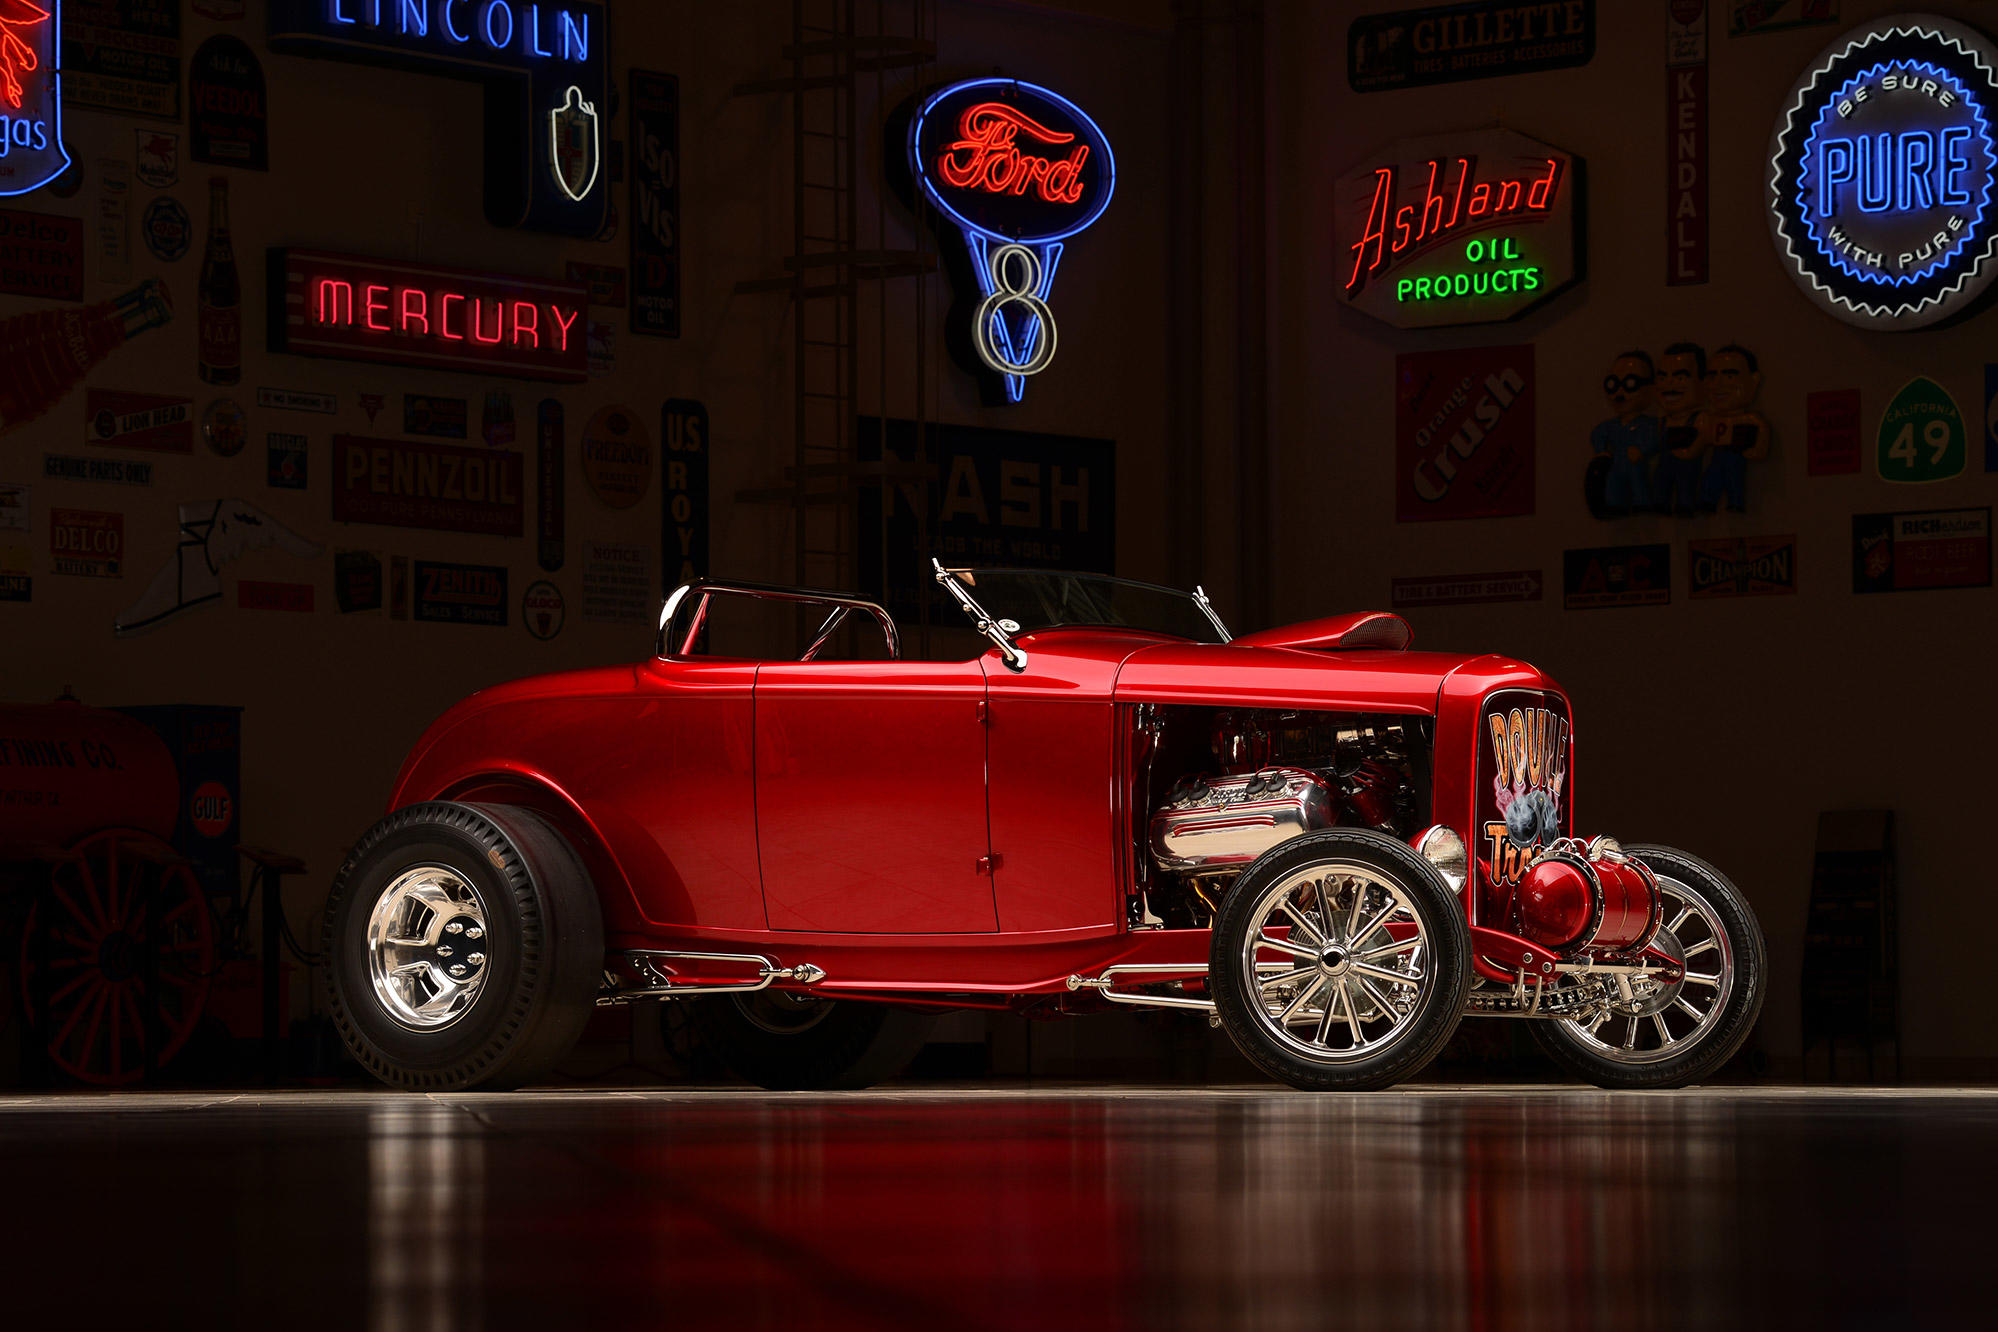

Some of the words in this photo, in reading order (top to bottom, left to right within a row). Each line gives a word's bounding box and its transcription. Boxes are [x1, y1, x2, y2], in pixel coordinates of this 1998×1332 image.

[1413, 2, 1585, 54] GILLETTE
[1414, 57, 1444, 73] TIRES
[1451, 51, 1506, 70] BATTERIES
[1513, 40, 1585, 61] ACCESSORIES
[192, 80, 265, 120] VEEDOL
[1836, 86, 1870, 118] BE
[1882, 75, 1957, 108] SURE
[943, 101, 1090, 205] Ford
[1675, 71, 1699, 279] KENDALL
[1818, 127, 1973, 218] PURE
[1345, 154, 1566, 298] Ashland
[1827, 226, 1886, 269] WITH
[1899, 214, 1964, 269] PURE
[1466, 238, 1523, 262] OIL
[1397, 267, 1543, 302] PRODUCTS
[314, 278, 579, 353] MERCURY
[638, 297, 675, 313] MOTOR
[646, 313, 667, 327] OIL
[154, 406, 186, 426] HEAD
[1415, 376, 1474, 449] Orange
[1886, 402, 1958, 425] CALIFORNIA
[1411, 366, 1524, 502] Crush
[1888, 423, 1953, 468] 49
[91, 461, 124, 481] PARTS
[126, 463, 152, 484] ONLY
[344, 444, 518, 507] PENNZOIL
[884, 447, 1090, 535] NASH
[381, 499, 417, 519] PURE
[53, 524, 120, 554] DELCO
[593, 547, 641, 563] NOTICE
[975, 536, 1001, 555] THE
[1010, 540, 1061, 560] WORLD
[421, 566, 502, 606] ZENITH
[1694, 549, 1788, 585] CHAMPION
[1398, 587, 1422, 599] TIRE
[1435, 584, 1482, 597] BATTERY
[1485, 581, 1530, 594] SERVICE
[194, 796, 230, 822] GULF
